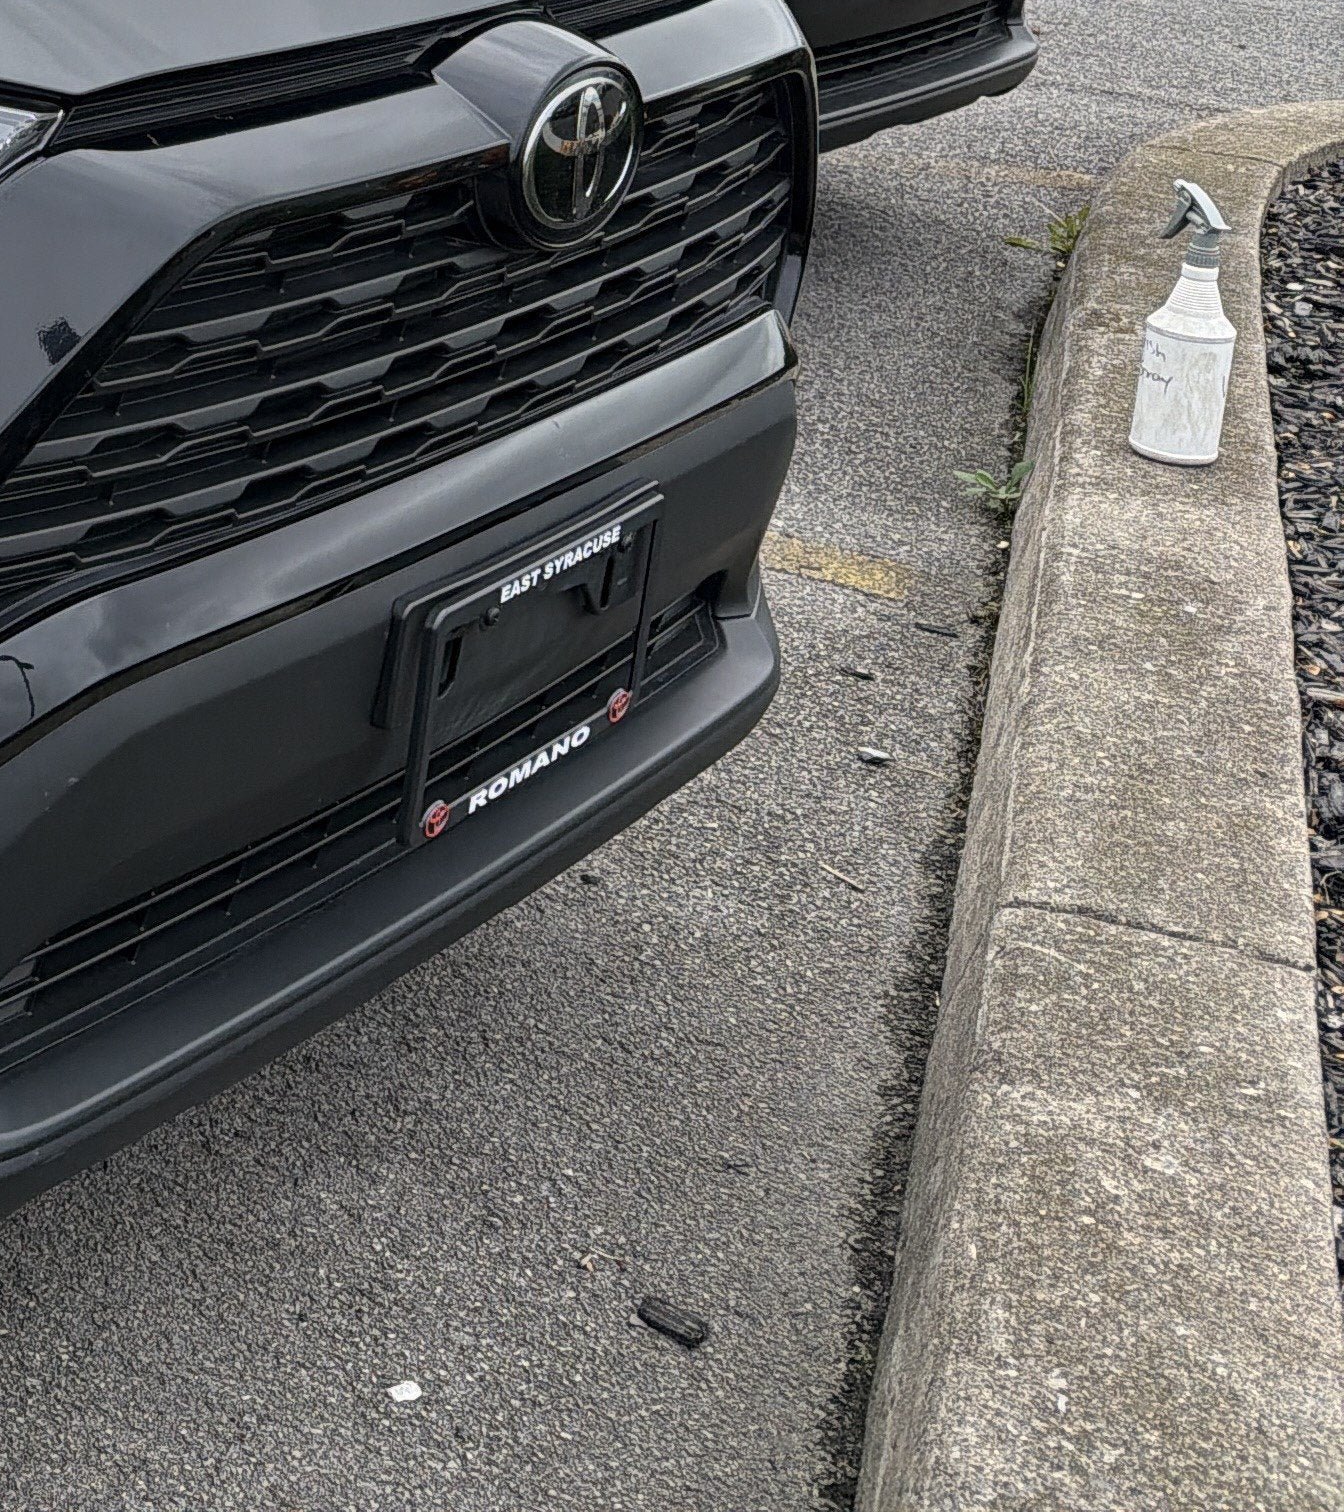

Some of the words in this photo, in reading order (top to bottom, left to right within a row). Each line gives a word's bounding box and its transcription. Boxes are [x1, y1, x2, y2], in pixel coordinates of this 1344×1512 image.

[499, 567, 542, 604] EAST
[544, 524, 622, 580] SYRACUSE
[467, 725, 591, 815] ROMANO
